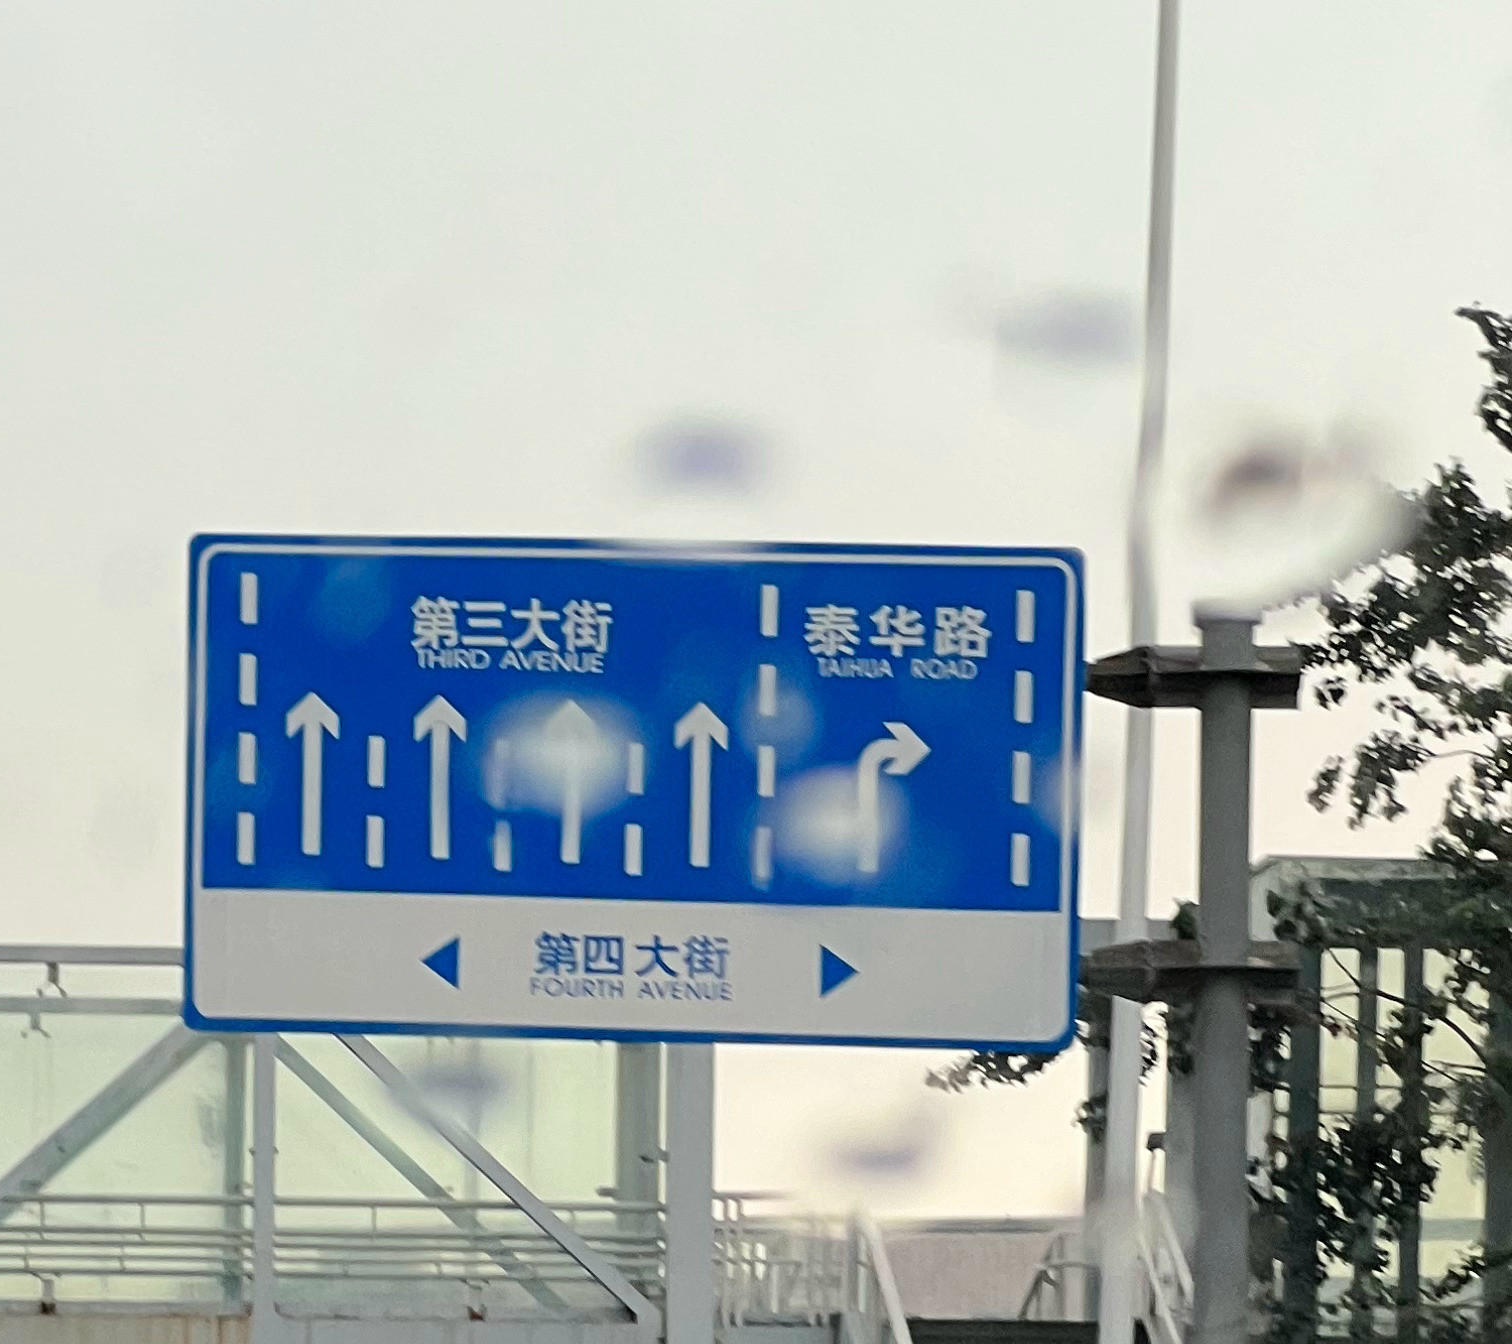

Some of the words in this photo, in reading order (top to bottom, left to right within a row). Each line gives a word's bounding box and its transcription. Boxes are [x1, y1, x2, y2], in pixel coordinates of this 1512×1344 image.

[410, 596, 614, 653] 第三大街
[803, 604, 993, 658] 泰华路
[417, 648, 491, 669] THIRD
[499, 650, 604, 673] AVENUE
[910, 658, 978, 680] ROAD
[534, 931, 729, 980] 第四大街
[530, 976, 624, 998] FOURTH
[639, 980, 734, 1001] AVENUE
